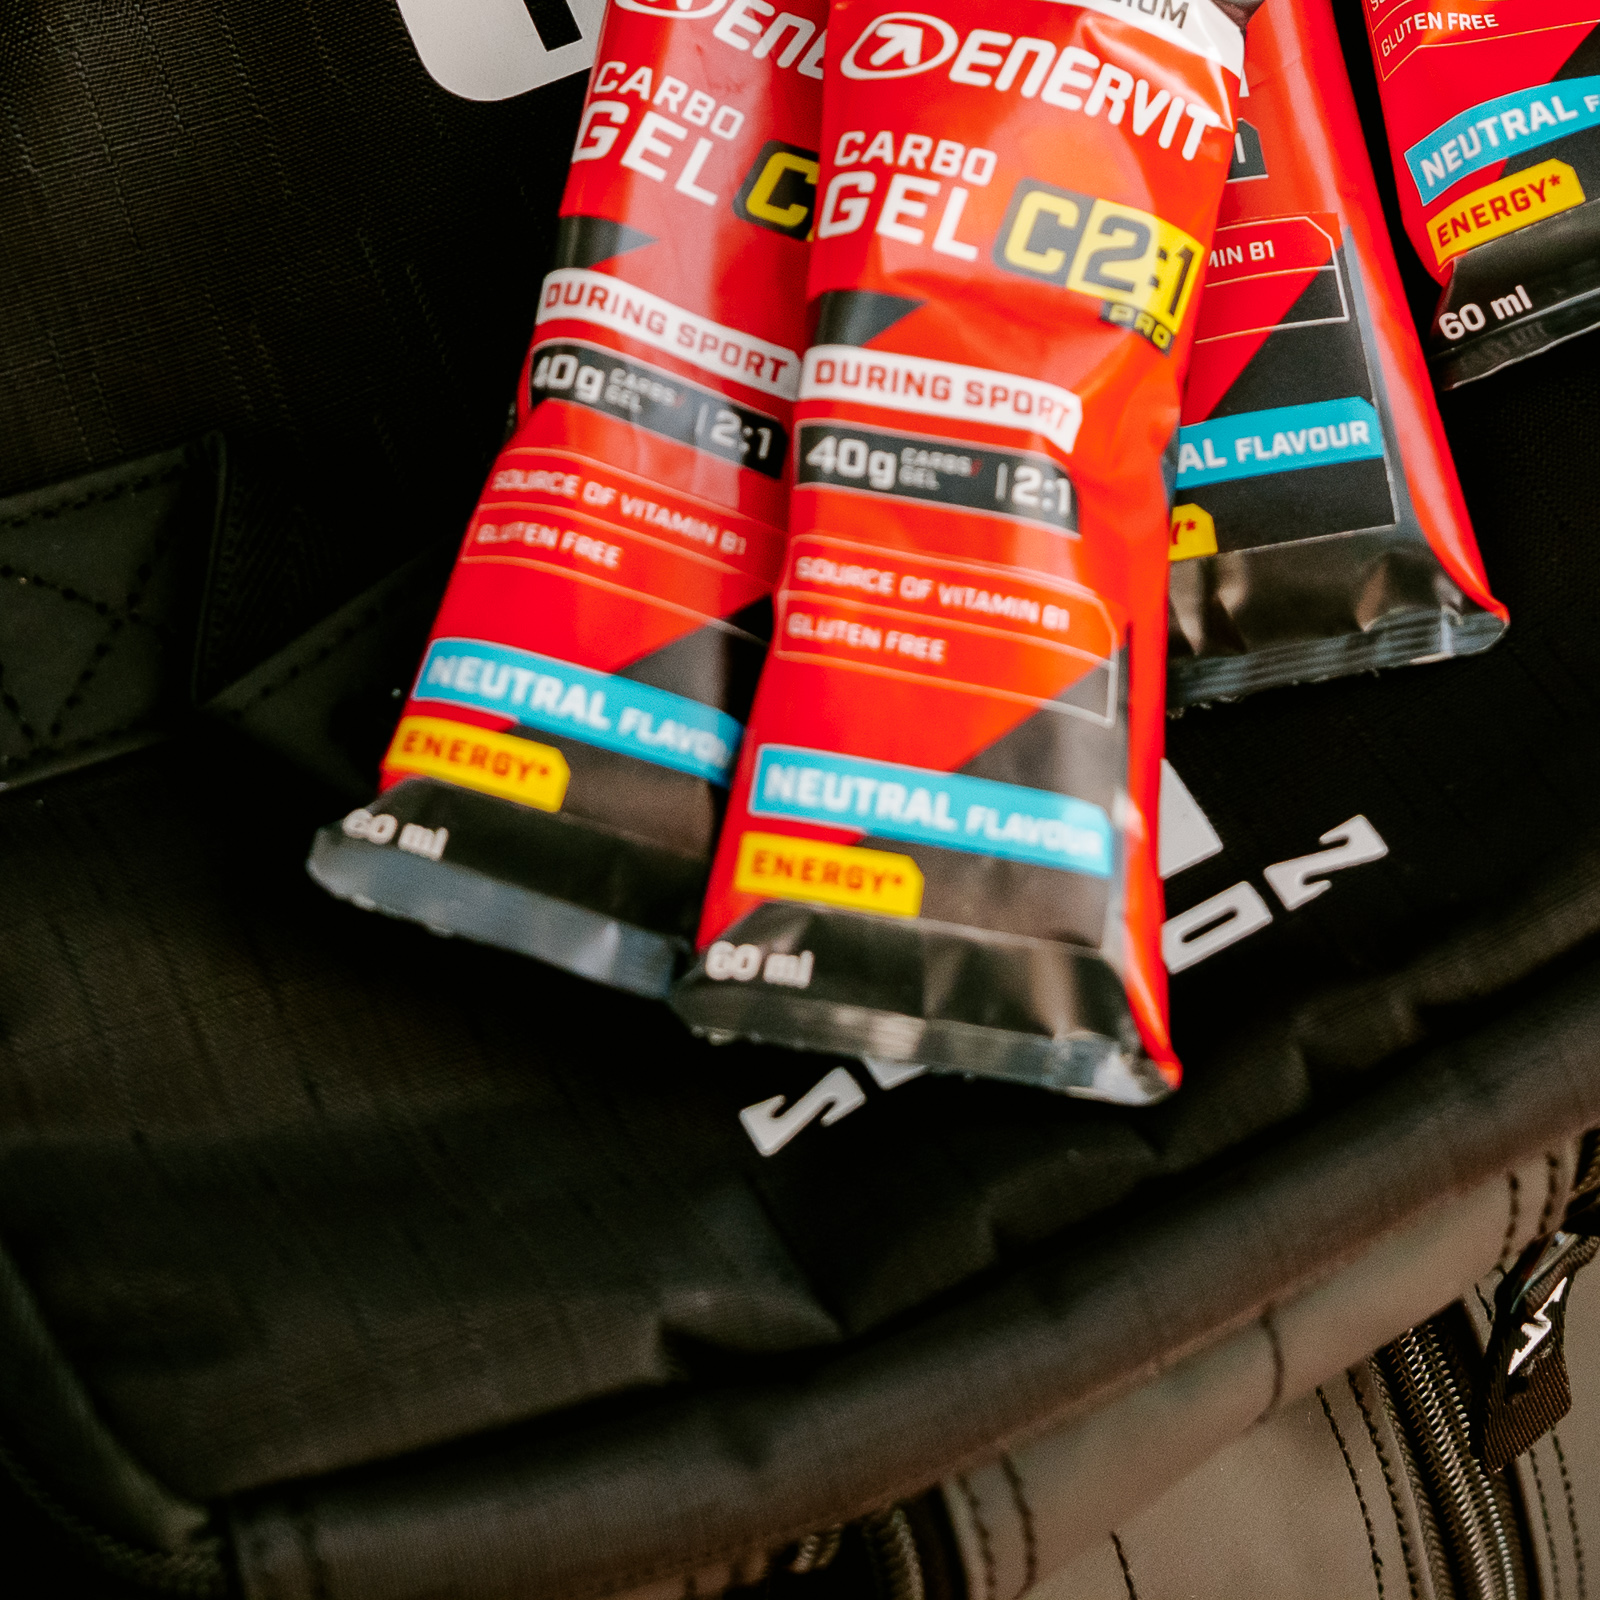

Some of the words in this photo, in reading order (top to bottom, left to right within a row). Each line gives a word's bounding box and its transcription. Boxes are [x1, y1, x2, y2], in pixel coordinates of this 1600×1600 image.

[1380, 13, 1443, 58] GLUTEN
[1447, 12, 1499, 31] FREE
[593, 60, 746, 141] CARBO
[948, 28, 1221, 161] ENERVIT
[571, 100, 720, 206] GEL
[833, 130, 998, 187] CARBO
[1419, 96, 1578, 187] NEUTRAL
[818, 170, 979, 262] GEL
[1003, 190, 1195, 318] C2:1
[1249, 241, 1275, 262] B1
[545, 281, 669, 336] DURING
[675, 321, 789, 384] SPORT
[1108, 303, 1173, 349] PRO
[1438, 303, 1486, 340] 60
[1490, 284, 1533, 320] ml
[604, 387, 642, 411] GEL
[813, 357, 953, 403] DURING
[964, 380, 1074, 431] SPORT
[710, 407, 773, 460] 2:1
[1235, 419, 1369, 463] FLAVOUR
[805, 435, 899, 491] 40g
[898, 467, 941, 492] GEL
[1011, 465, 1073, 517] 2:1
[491, 468, 580, 497] SOURCE
[581, 477, 616, 506] OF
[619, 491, 716, 547] VITAMIN
[718, 531, 746, 556] B1
[475, 522, 560, 551] GLUTEN
[560, 531, 623, 569] FREE
[795, 554, 895, 595] SOURCE
[898, 573, 934, 601] OF
[938, 582, 1040, 624] VITAMIN
[1040, 603, 1071, 633] B1
[787, 612, 882, 652] GLUTEN
[884, 633, 948, 665] FREE
[424, 653, 613, 732] NEUTRAL
[617, 705, 732, 770] FLAVO
[341, 807, 399, 846] 60
[397, 821, 449, 861] ml
[763, 761, 959, 833] NEUTRAL
[964, 804, 1103, 859] FLAVOUR
[703, 939, 762, 982] 60
[762, 948, 814, 991] ml
